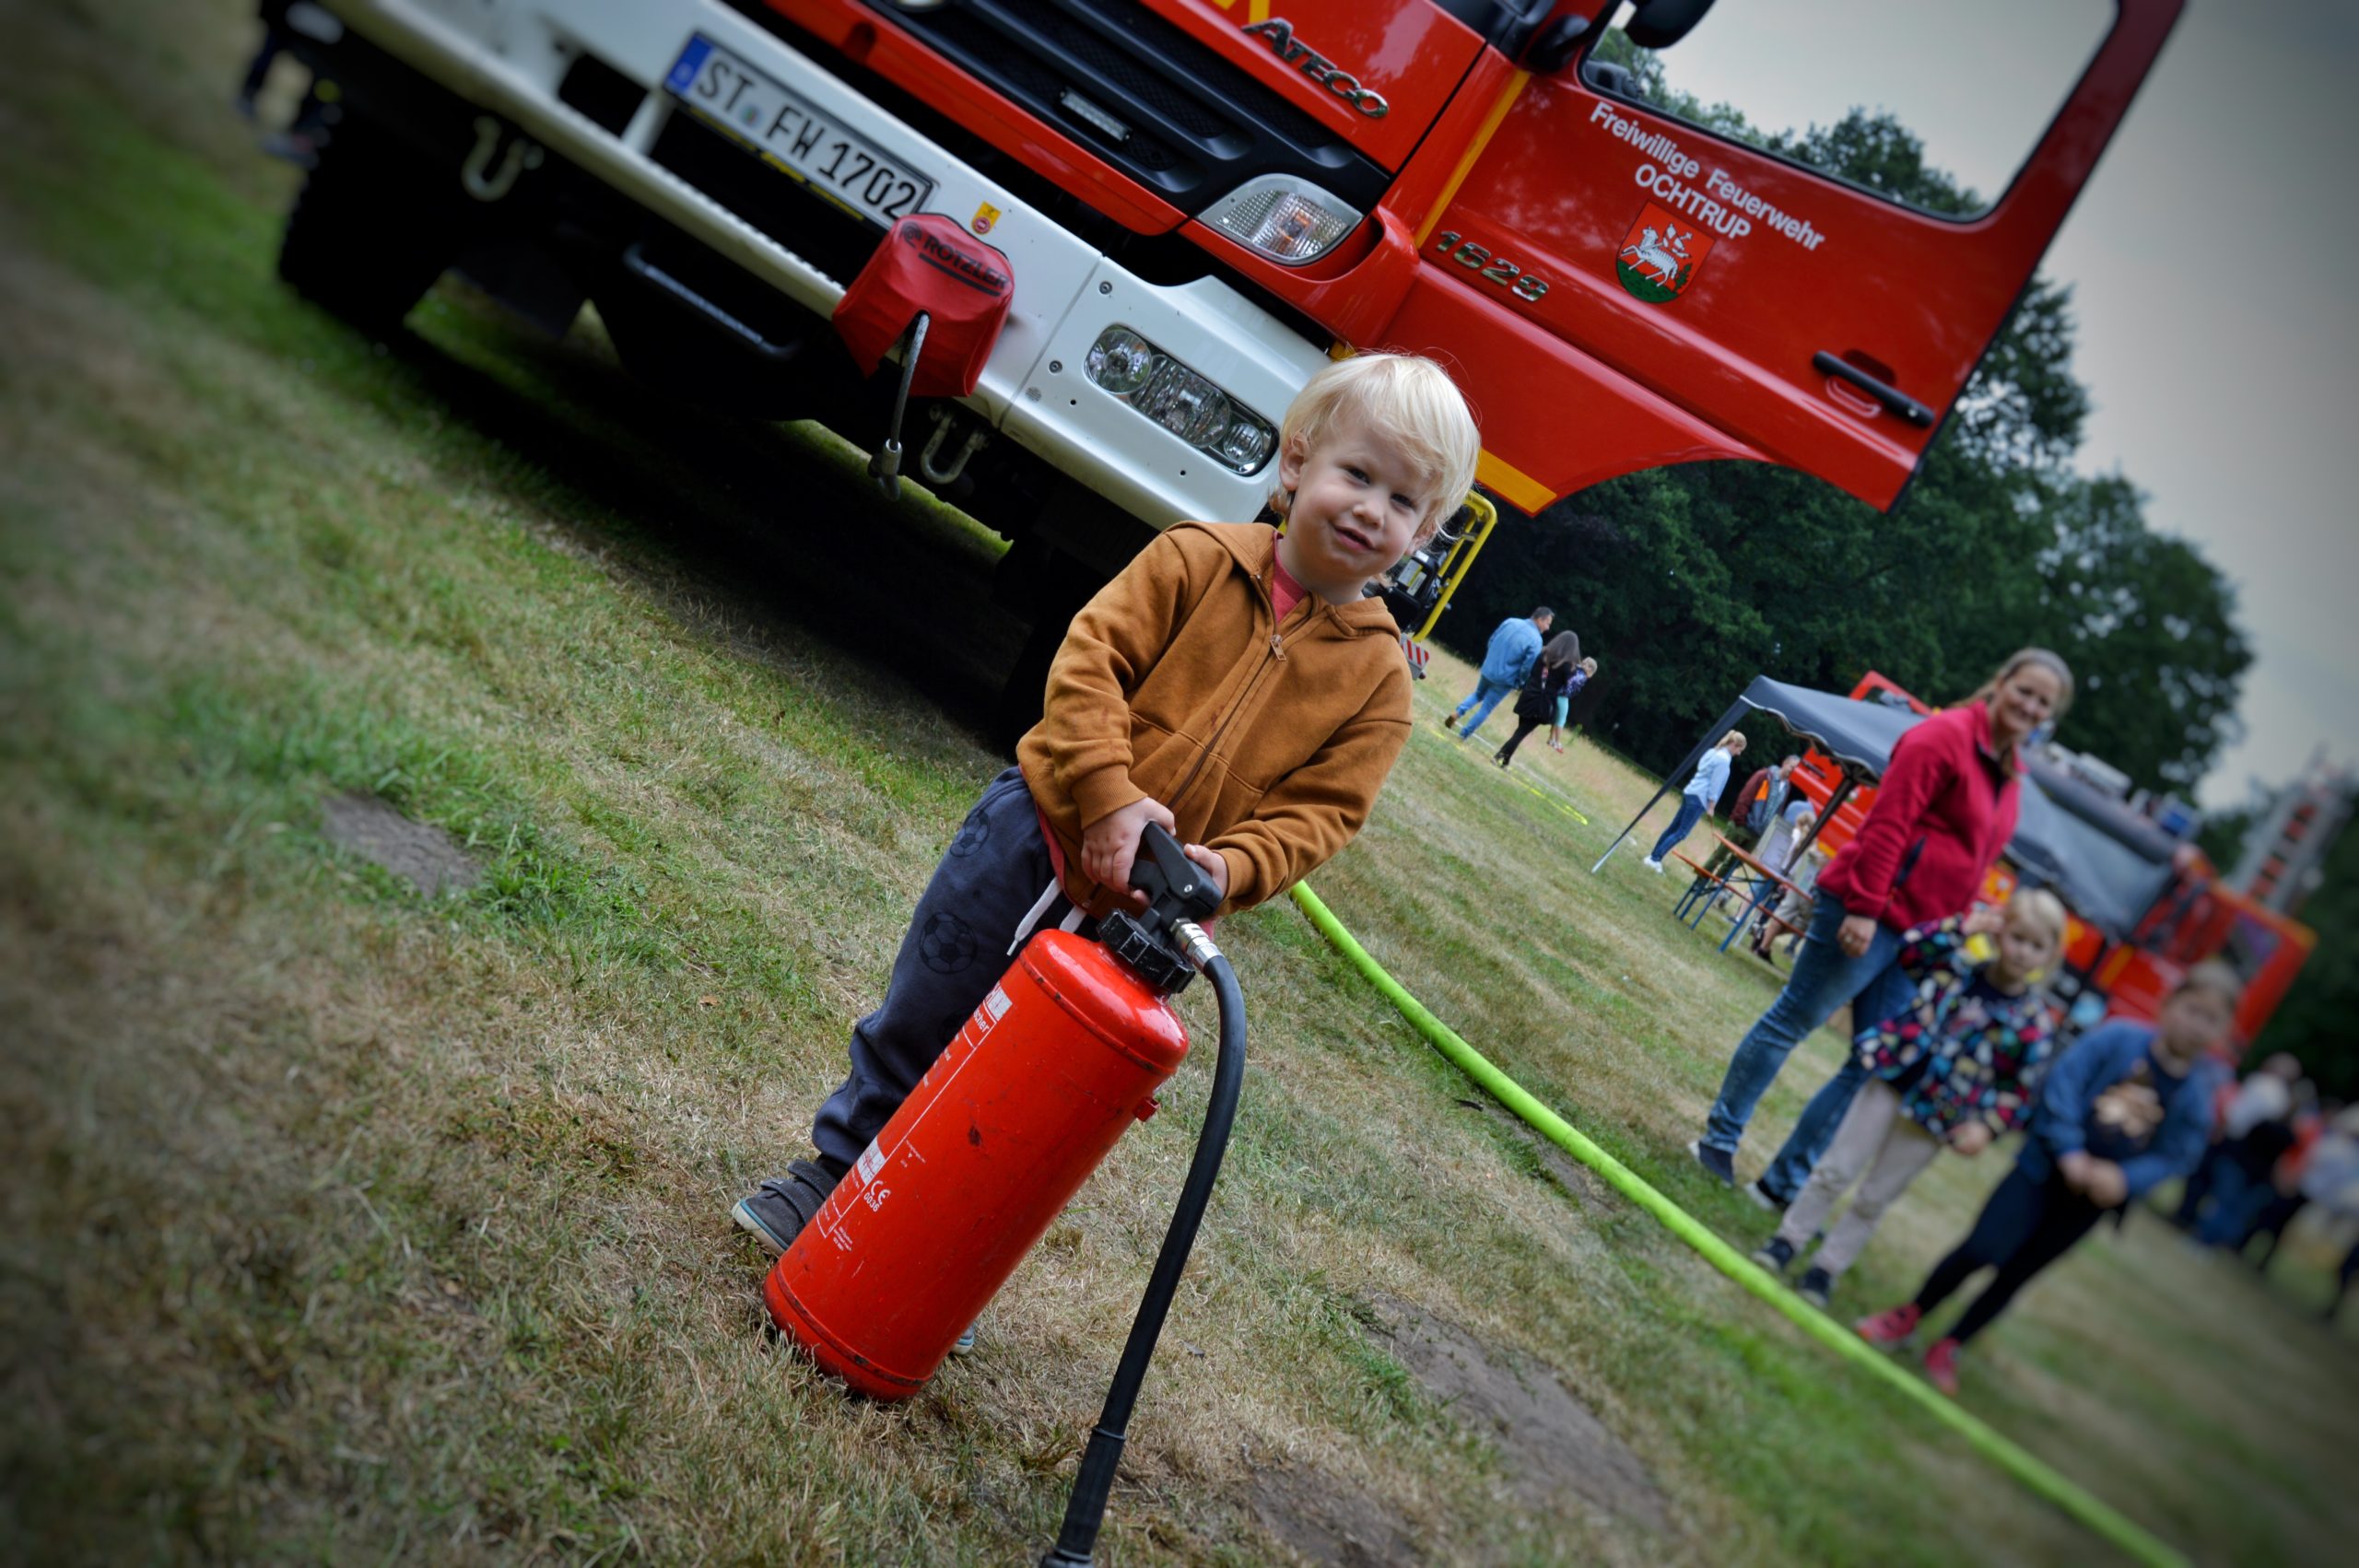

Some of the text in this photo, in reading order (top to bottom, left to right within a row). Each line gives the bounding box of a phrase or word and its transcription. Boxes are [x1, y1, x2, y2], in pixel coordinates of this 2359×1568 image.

[1241, 17, 1390, 119] ATECO
[698, 60, 756, 112] ST
[766, 105, 827, 160] FW
[817, 142, 918, 221] 1702
[1590, 101, 1825, 251] Freiwillige Feuerwehr
[1635, 163, 1752, 240] OCHTRUP
[922, 234, 1010, 290] ROTZLER
[1437, 230, 1550, 302] 1629
[863, 1191, 880, 1212] 0036
